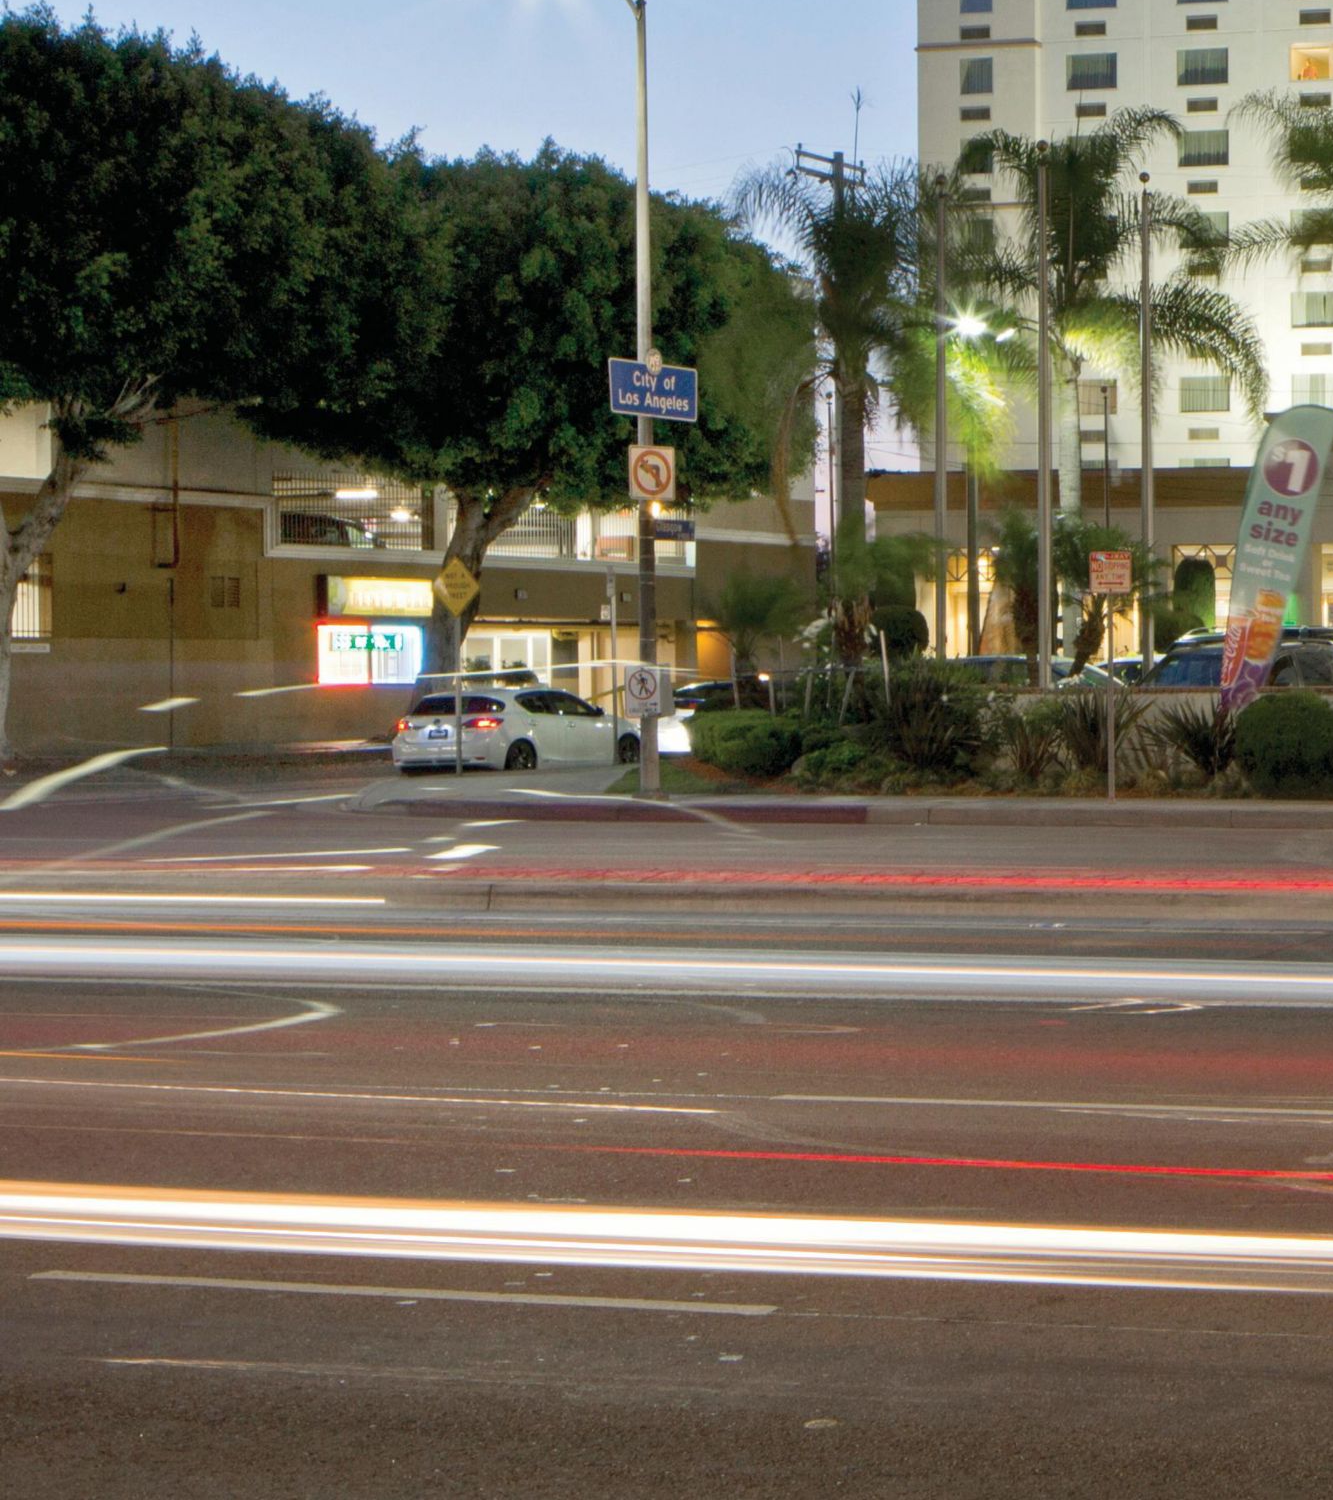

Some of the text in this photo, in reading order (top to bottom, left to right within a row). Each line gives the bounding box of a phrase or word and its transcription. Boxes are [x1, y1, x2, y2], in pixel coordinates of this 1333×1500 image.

[633, 370, 676, 392] City of
[618, 388, 689, 414] Los Angeles
[1257, 499, 1304, 527] any
[1249, 521, 1299, 548] size
[1091, 560, 1103, 572] NO
